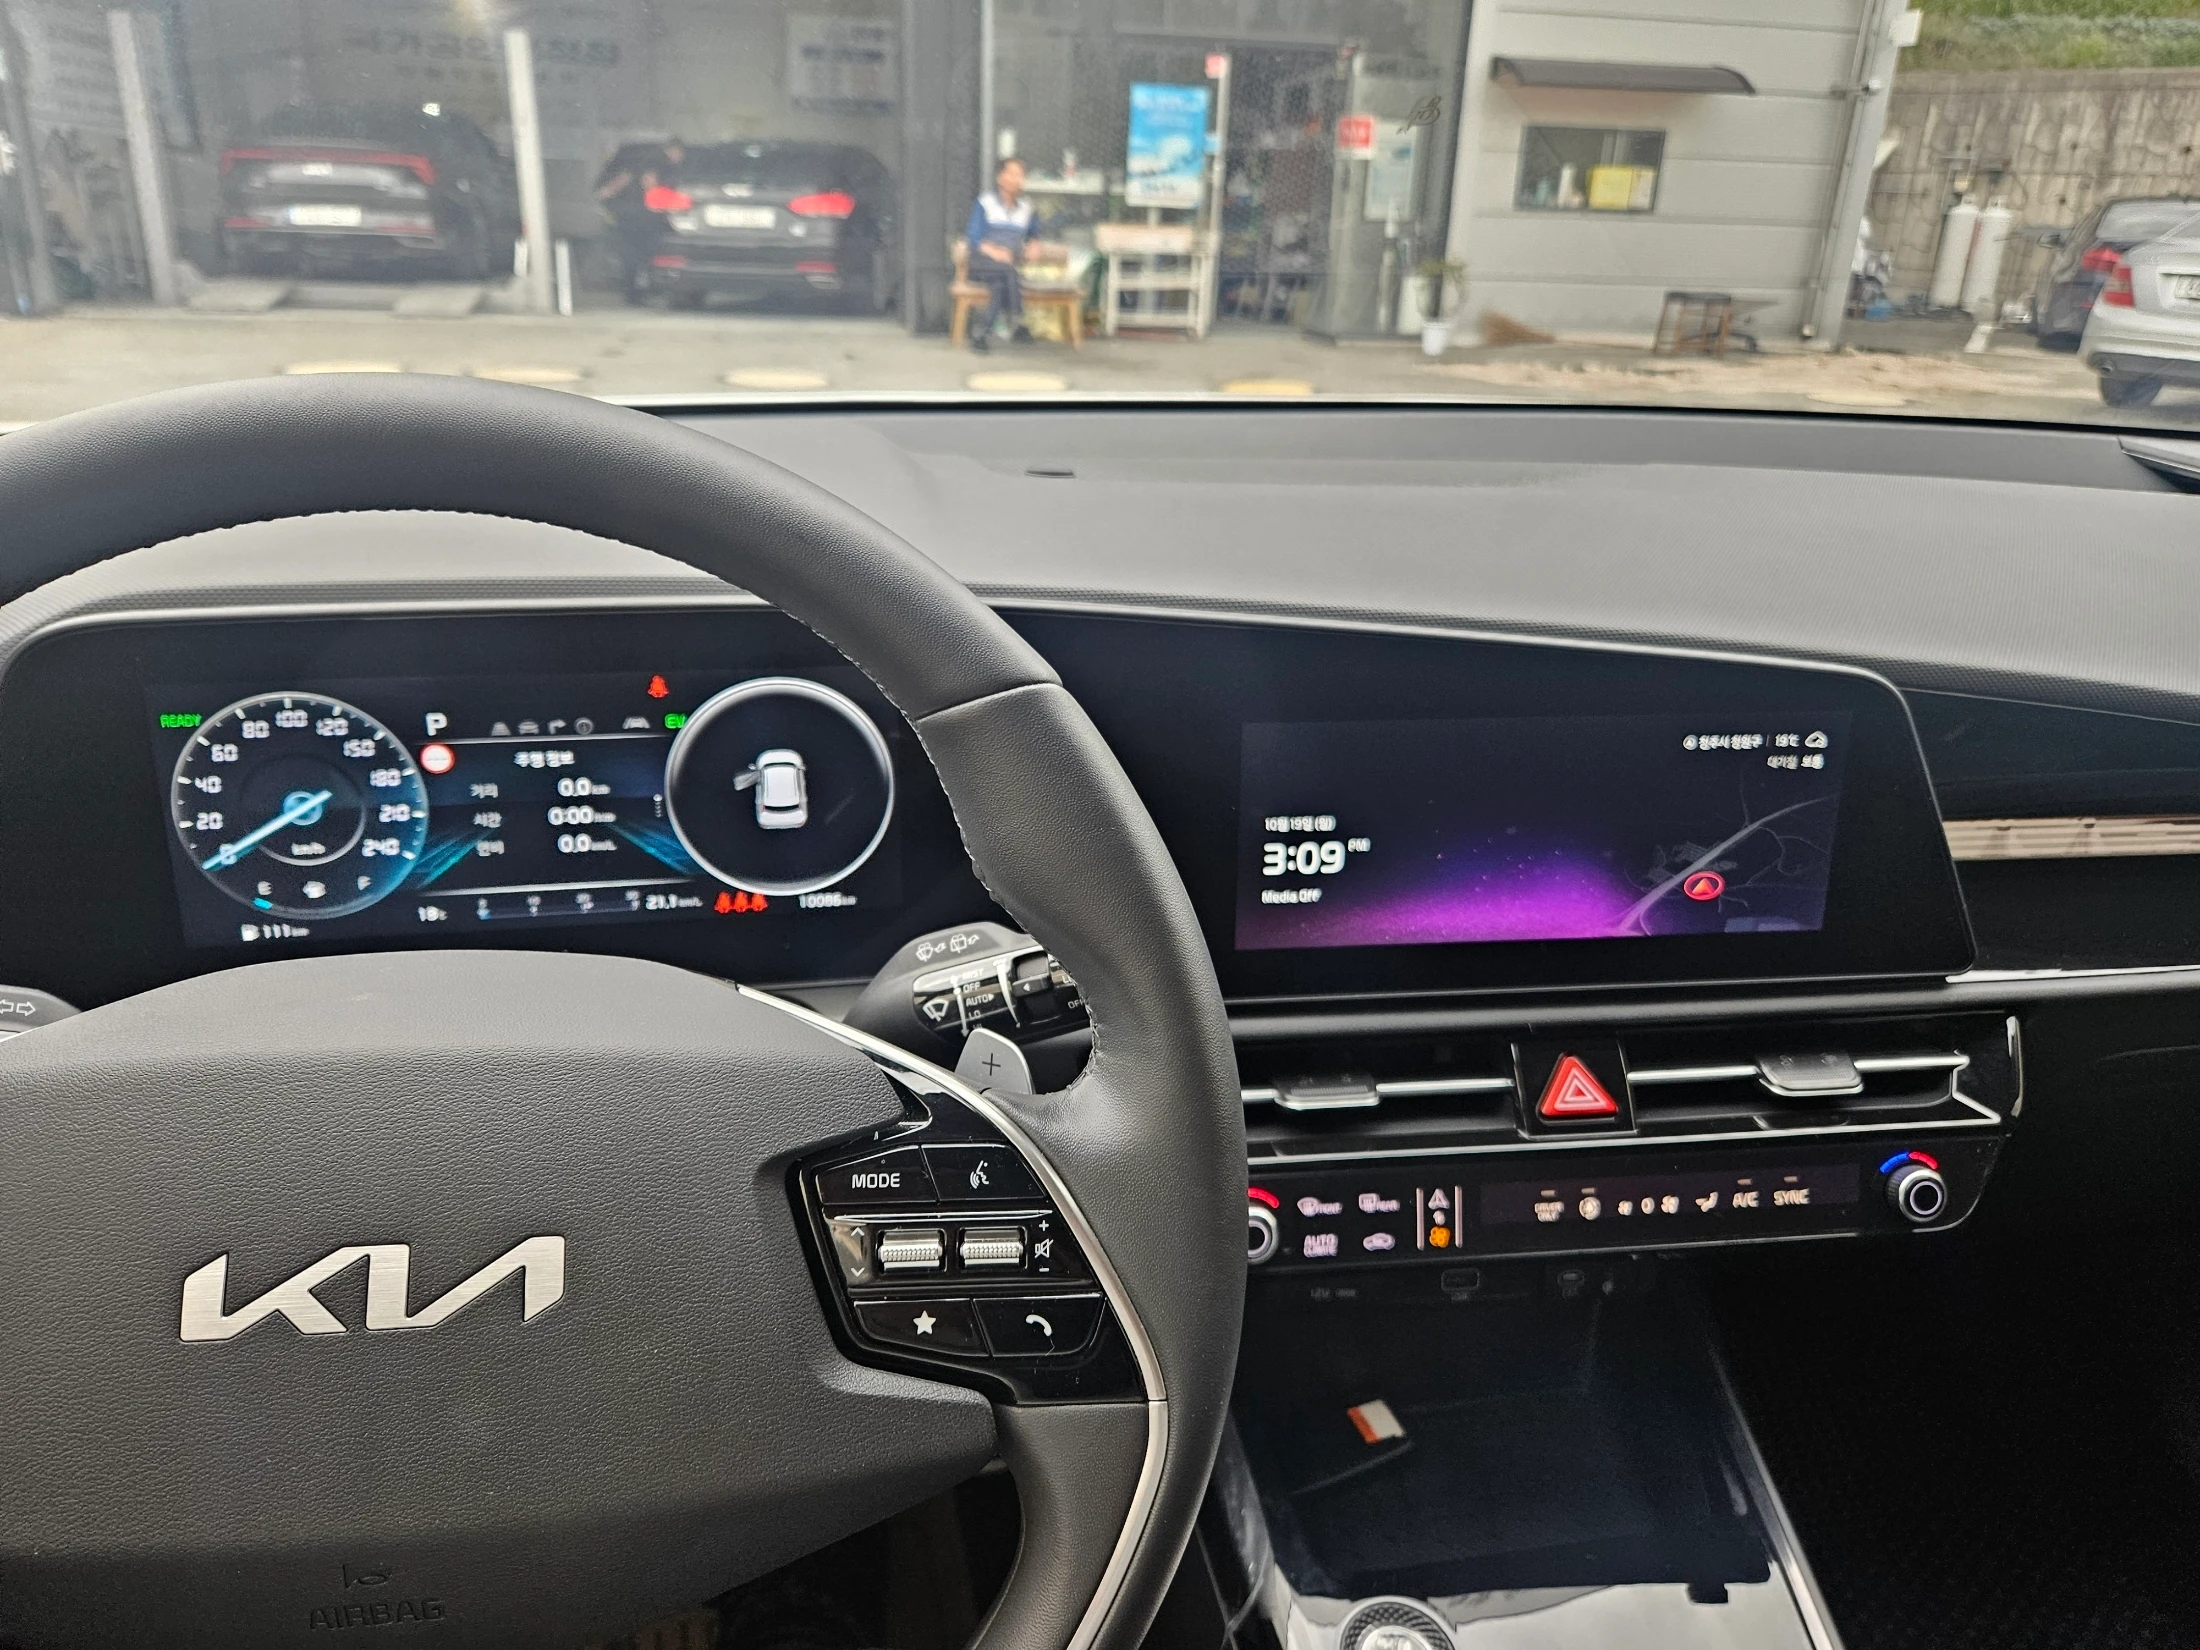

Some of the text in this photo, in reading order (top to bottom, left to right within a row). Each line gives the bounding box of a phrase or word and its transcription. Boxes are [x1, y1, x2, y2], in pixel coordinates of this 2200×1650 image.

[160, 713, 201, 728] READY
[275, 709, 308, 728] 100
[316, 717, 349, 737] 120
[425, 712, 448, 737] P
[664, 713, 687, 729] EV
[242, 720, 270, 739] 80
[211, 743, 239, 763] 60
[194, 775, 223, 794] 40
[196, 812, 224, 831] 20
[1290, 815, 1314, 832] 19일
[361, 837, 400, 857] 240
[1262, 838, 1371, 876] 3:09 PM
[1261, 888, 1322, 905] Media Off
[963, 982, 981, 993] OFF
[965, 994, 989, 1007] AUTO
[851, 1172, 901, 1190] MODE
[1773, 1188, 1810, 1206] SYNC
[1304, 1233, 1338, 1247] AUTO
[180, 1235, 565, 1342] KIA
[310, 1600, 446, 1631] AIRBAG
